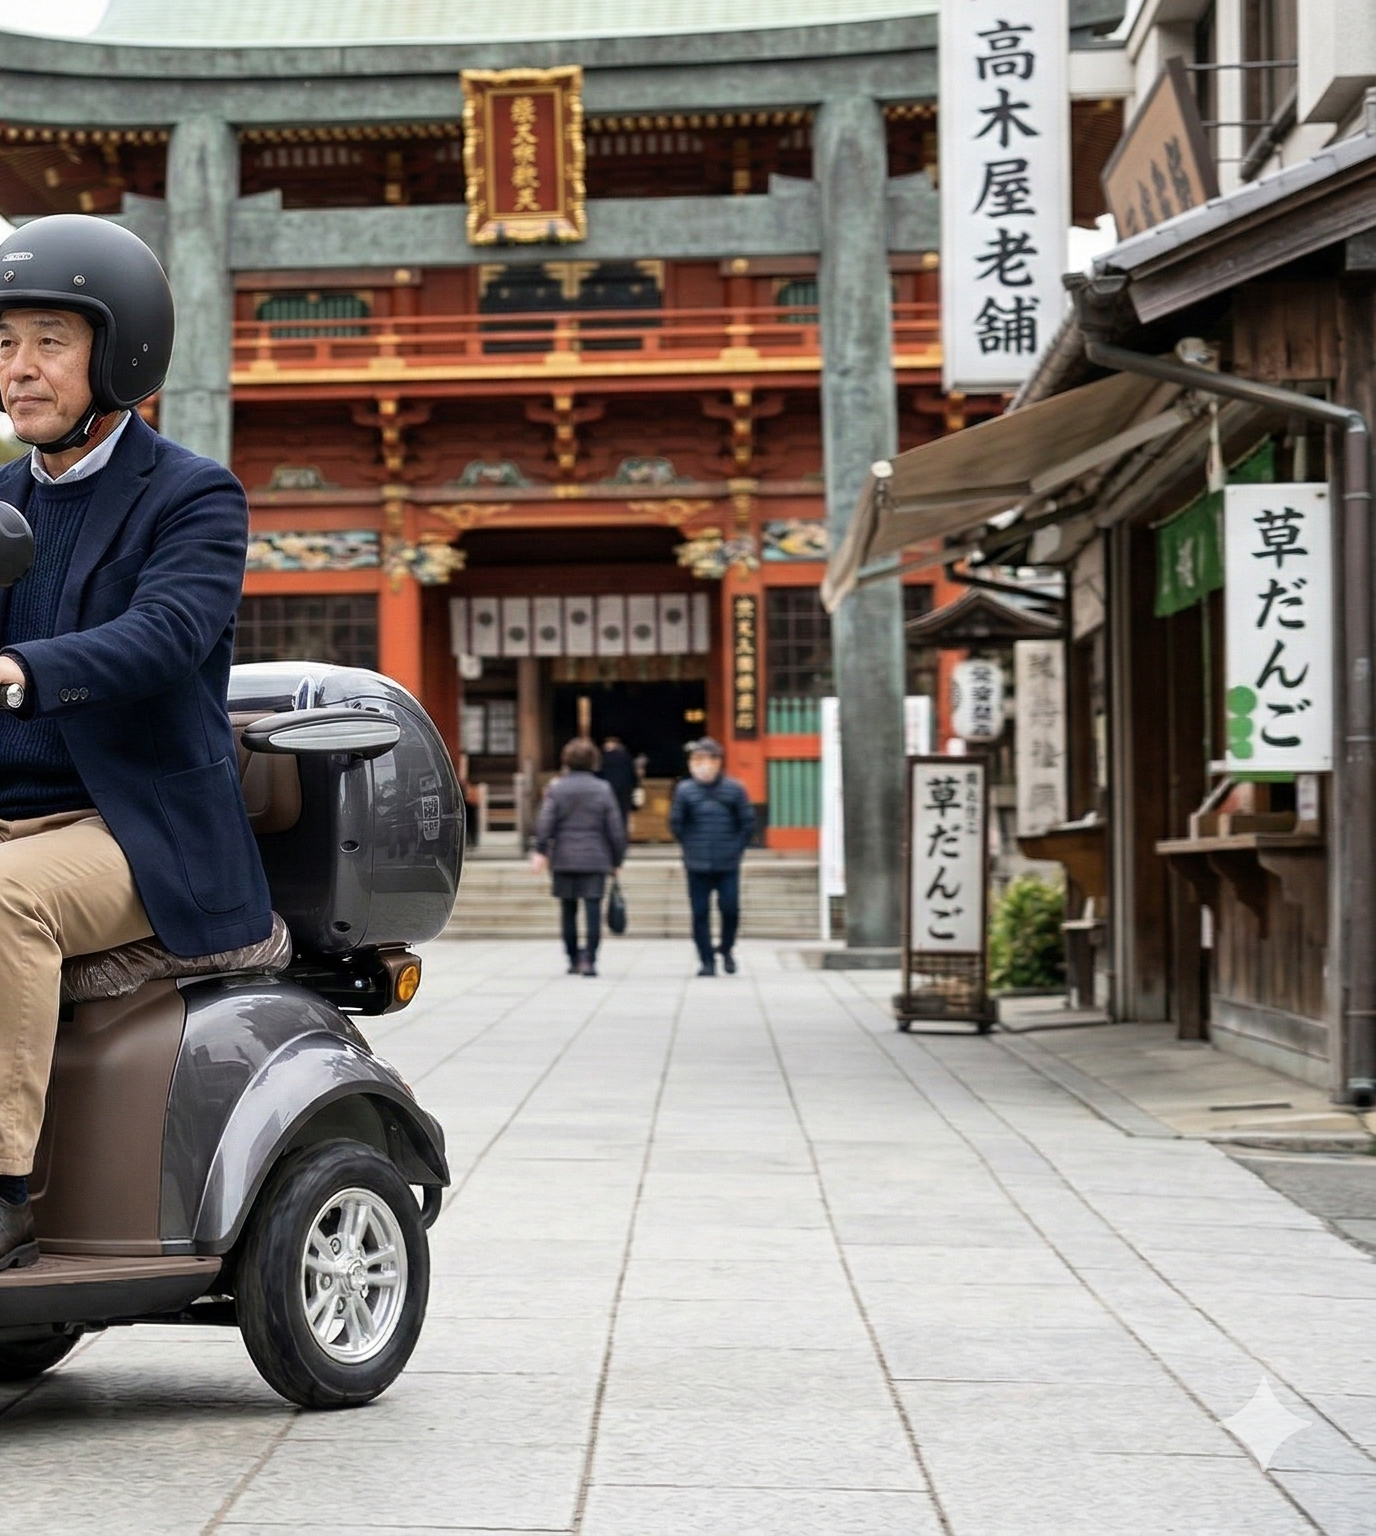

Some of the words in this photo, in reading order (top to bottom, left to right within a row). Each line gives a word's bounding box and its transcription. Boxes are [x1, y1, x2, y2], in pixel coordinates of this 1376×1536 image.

[972, 20, 1040, 354] 高木屋老舗
[1251, 507, 1312, 748] 草だんご
[924, 775, 964, 940] 草だんご
